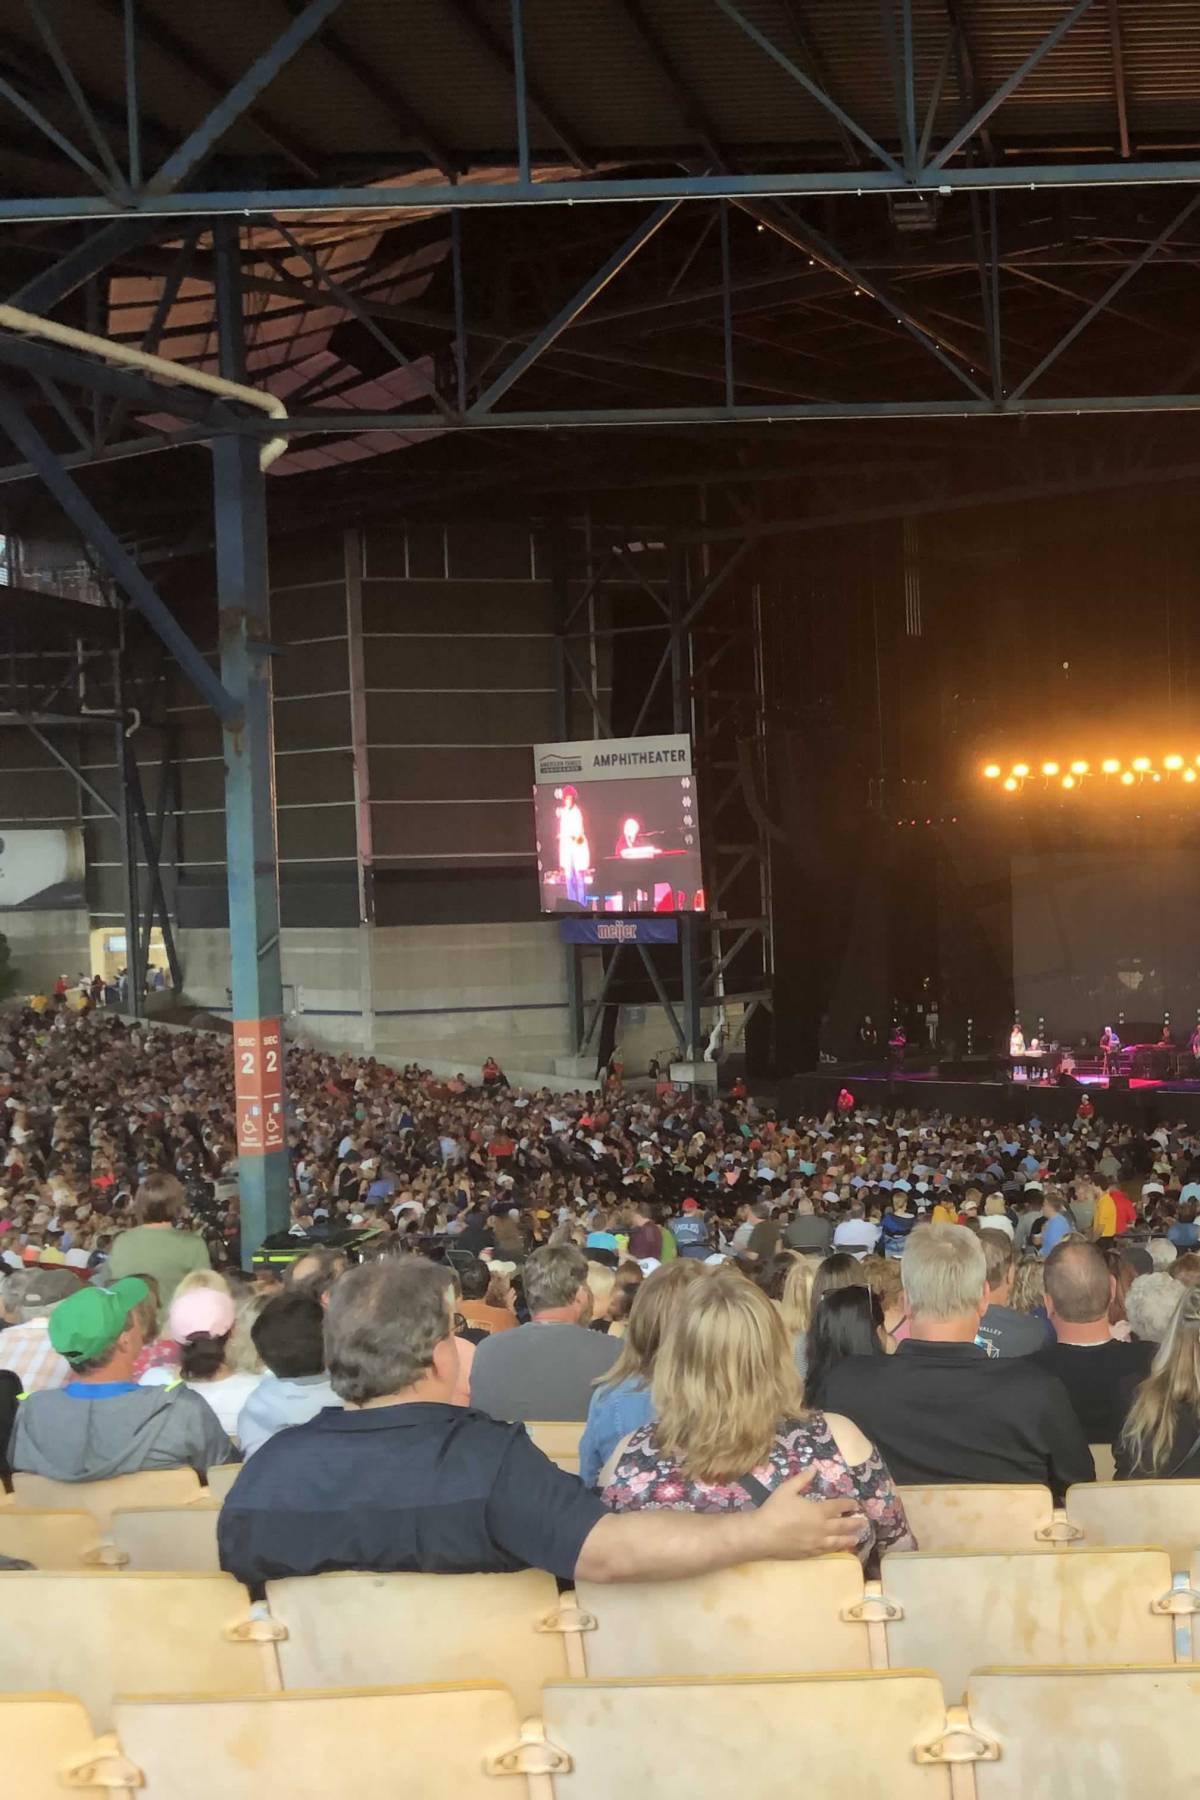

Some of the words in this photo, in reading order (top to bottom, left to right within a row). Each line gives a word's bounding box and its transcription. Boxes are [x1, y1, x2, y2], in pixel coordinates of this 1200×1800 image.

[593, 750, 686, 767] AMPHITHEATER
[597, 920, 637, 943] meijer
[241, 1052, 255, 1074] 2
[266, 1051, 277, 1073] 2
